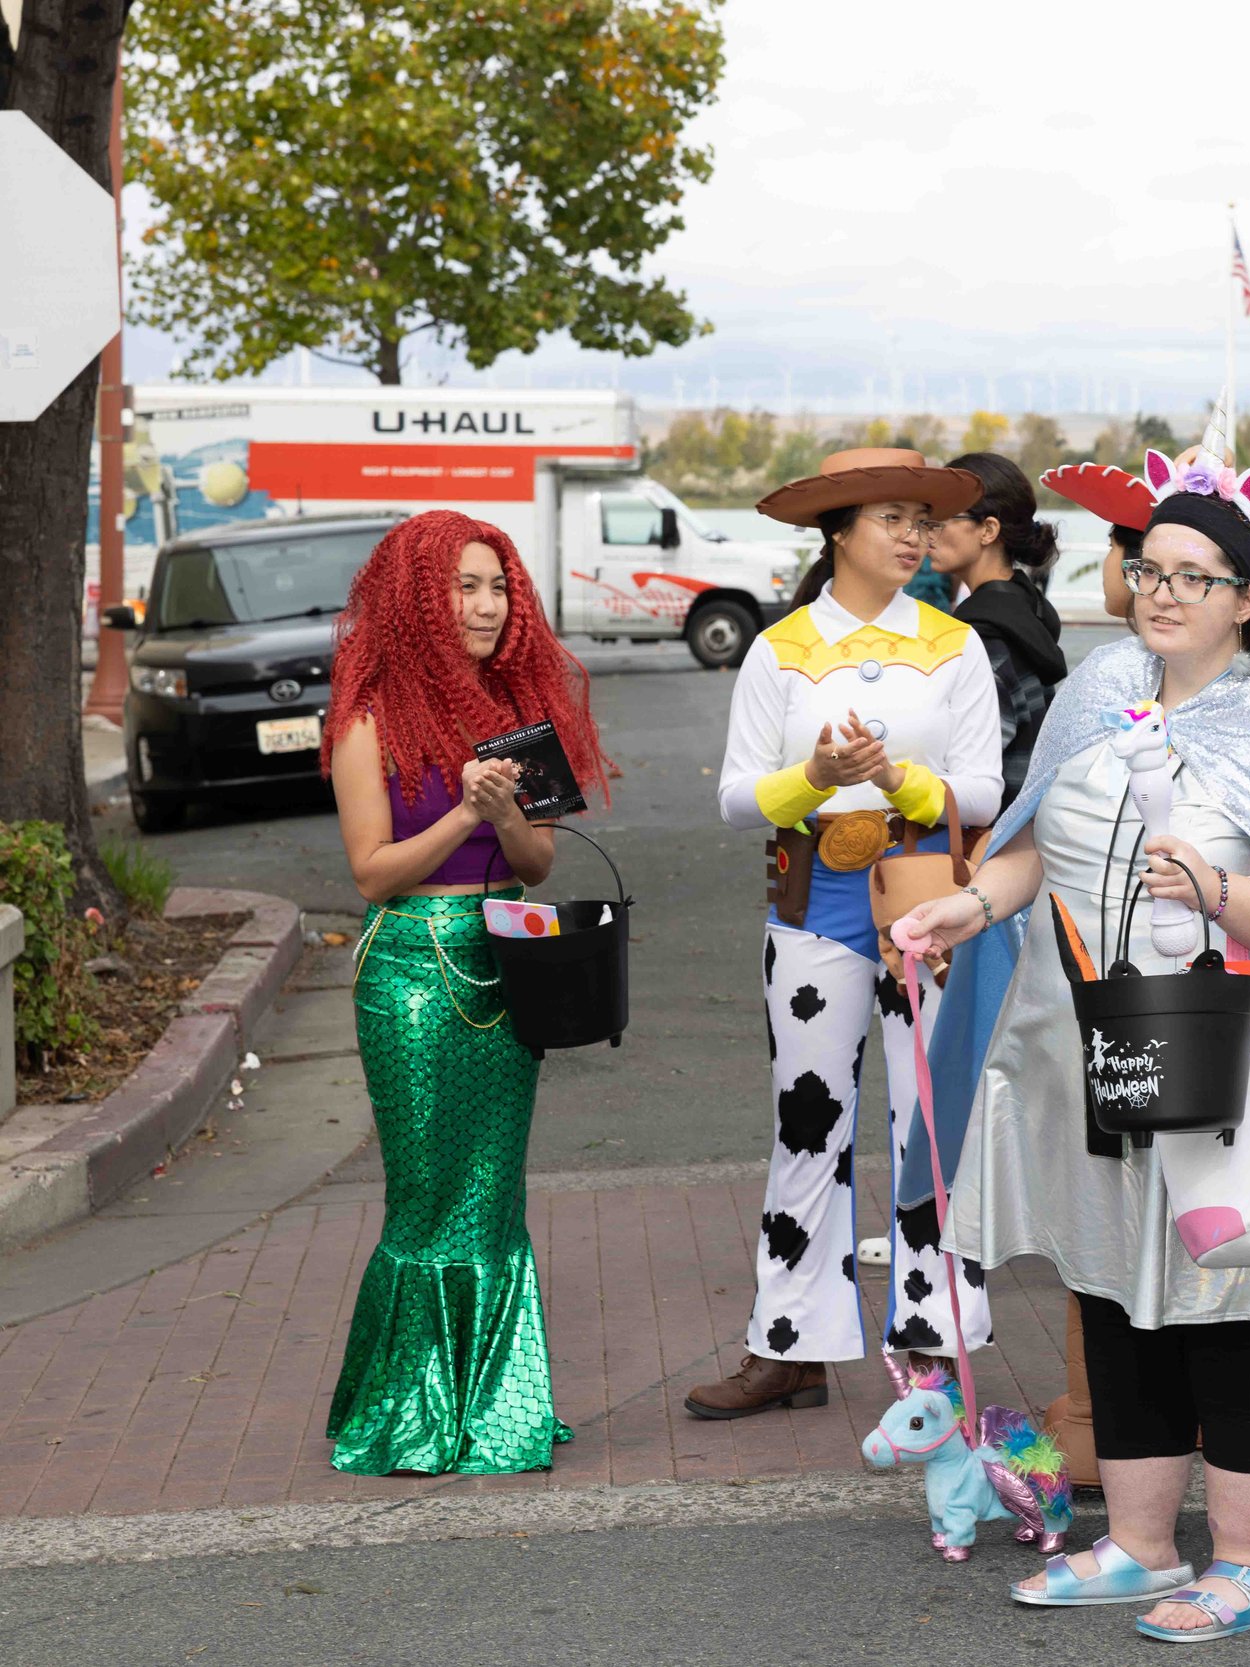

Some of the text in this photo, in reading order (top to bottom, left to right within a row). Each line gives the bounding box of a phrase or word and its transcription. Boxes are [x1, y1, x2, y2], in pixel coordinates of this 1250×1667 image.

[373, 411, 535, 433] U-HAUL
[523, 795, 559, 810] HUMBUG
[1106, 1053, 1154, 1072] Happy
